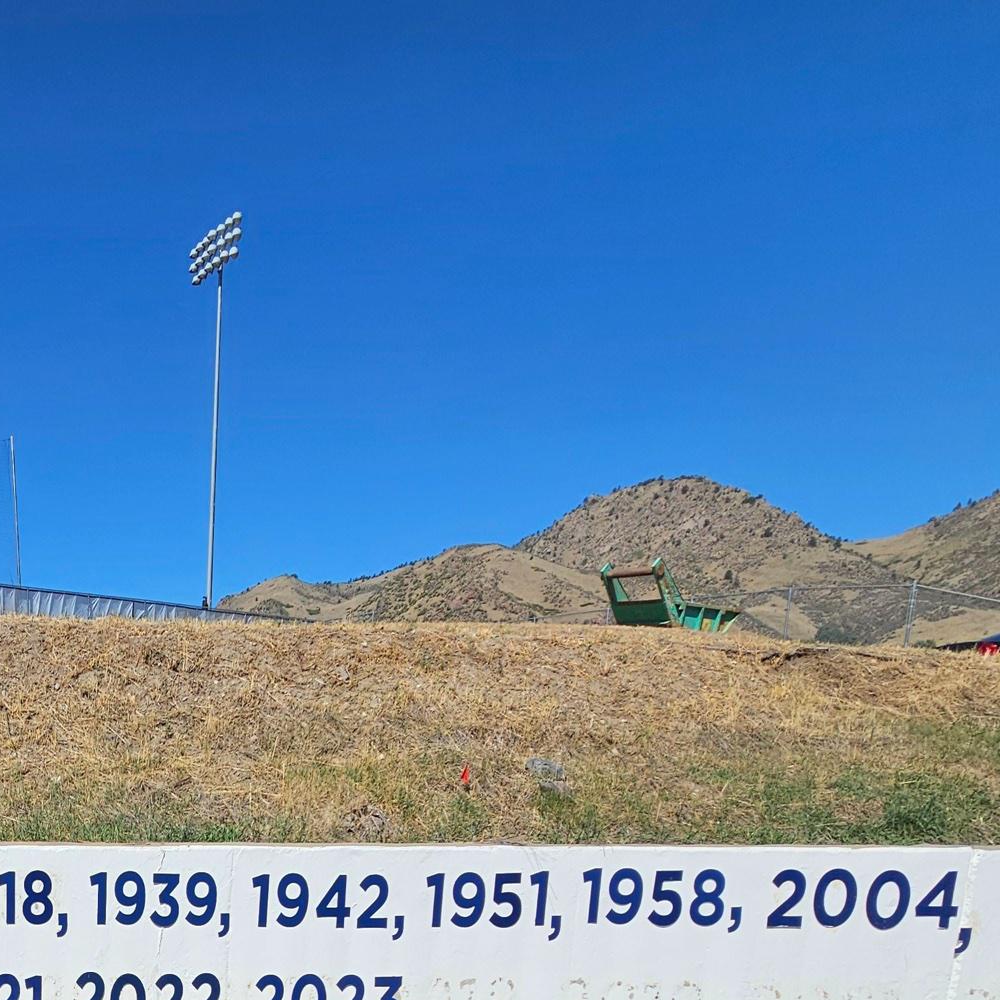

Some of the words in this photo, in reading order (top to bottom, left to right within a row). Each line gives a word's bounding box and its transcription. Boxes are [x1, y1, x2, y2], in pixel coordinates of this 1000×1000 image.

[89, 870, 230, 938] 1939,
[252, 872, 405, 941] 1942,
[426, 870, 562, 941] 1951,
[582, 868, 742, 933] 1958,
[766, 868, 972, 957] 2004,
